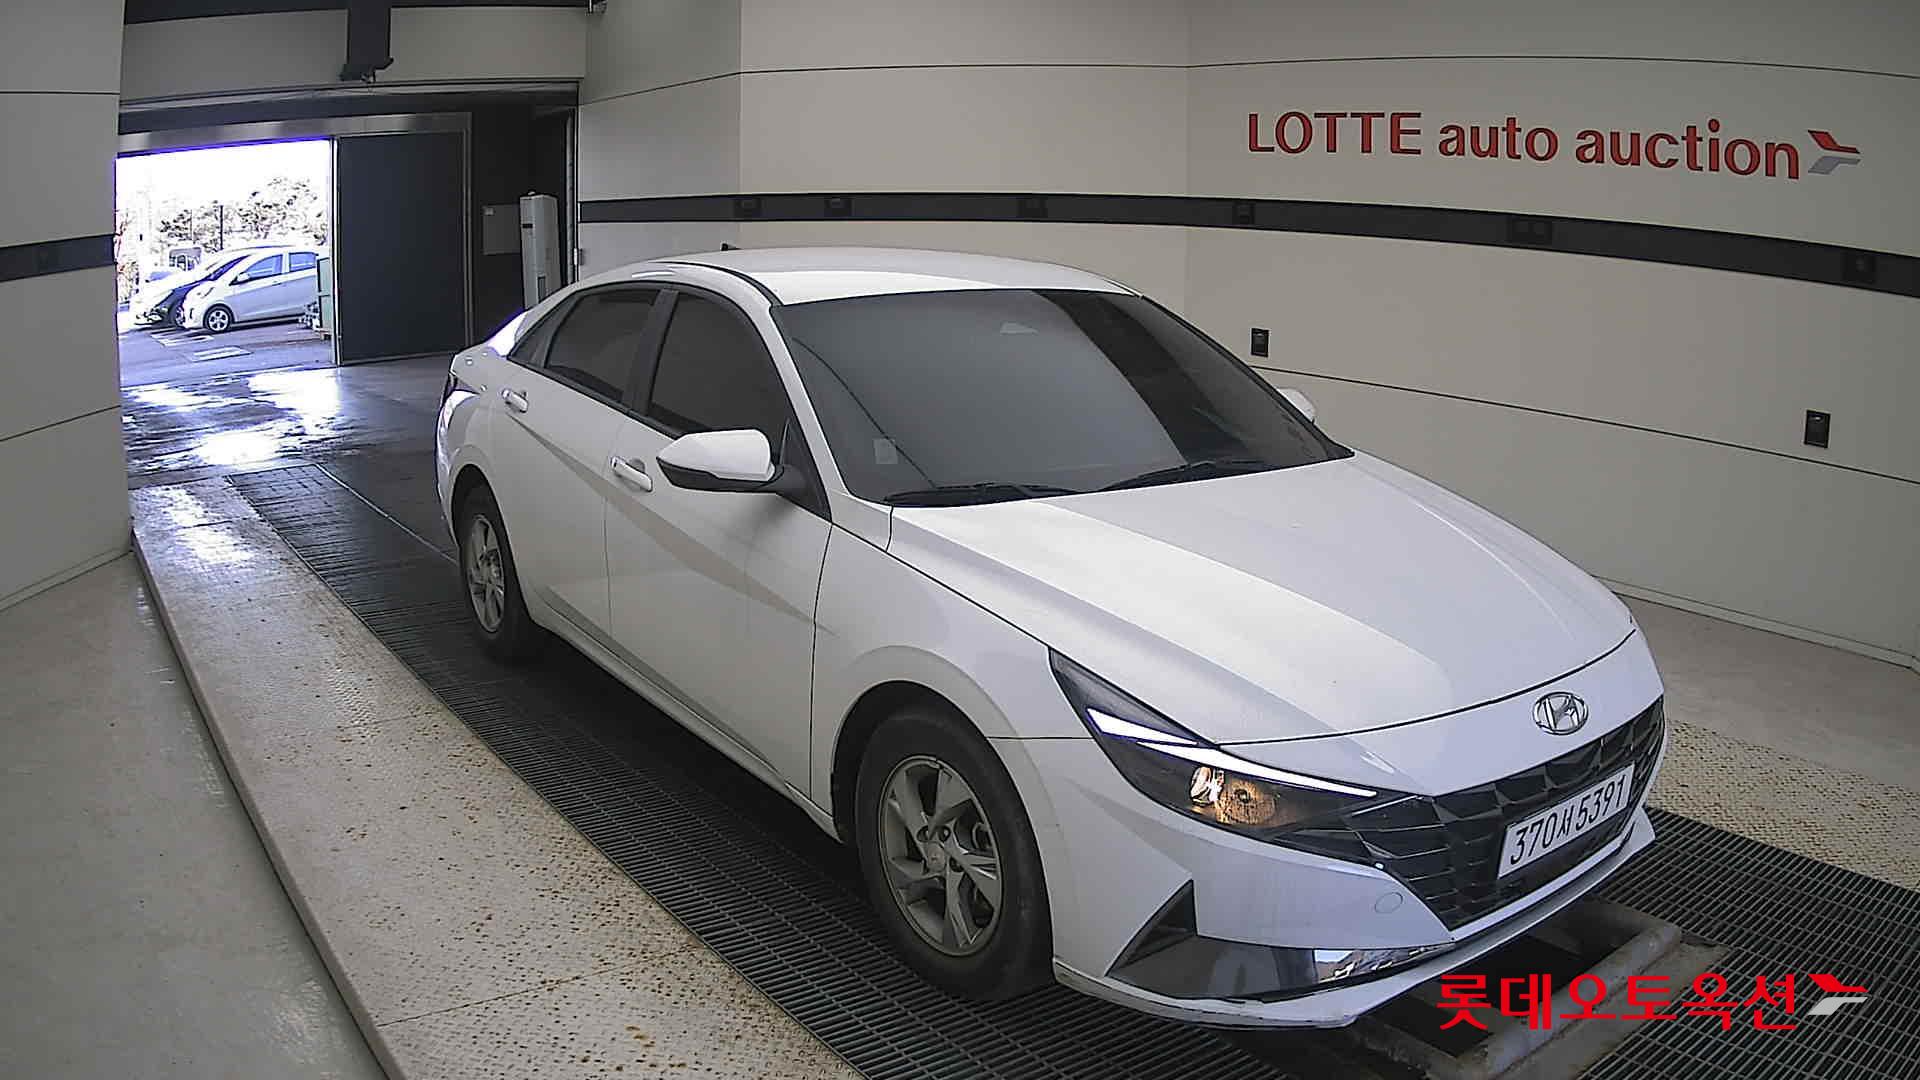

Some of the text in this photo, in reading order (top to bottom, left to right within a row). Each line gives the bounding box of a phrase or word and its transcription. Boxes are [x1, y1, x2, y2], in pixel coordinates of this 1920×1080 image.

[1248, 112, 1800, 180] LOTTE auto auction
